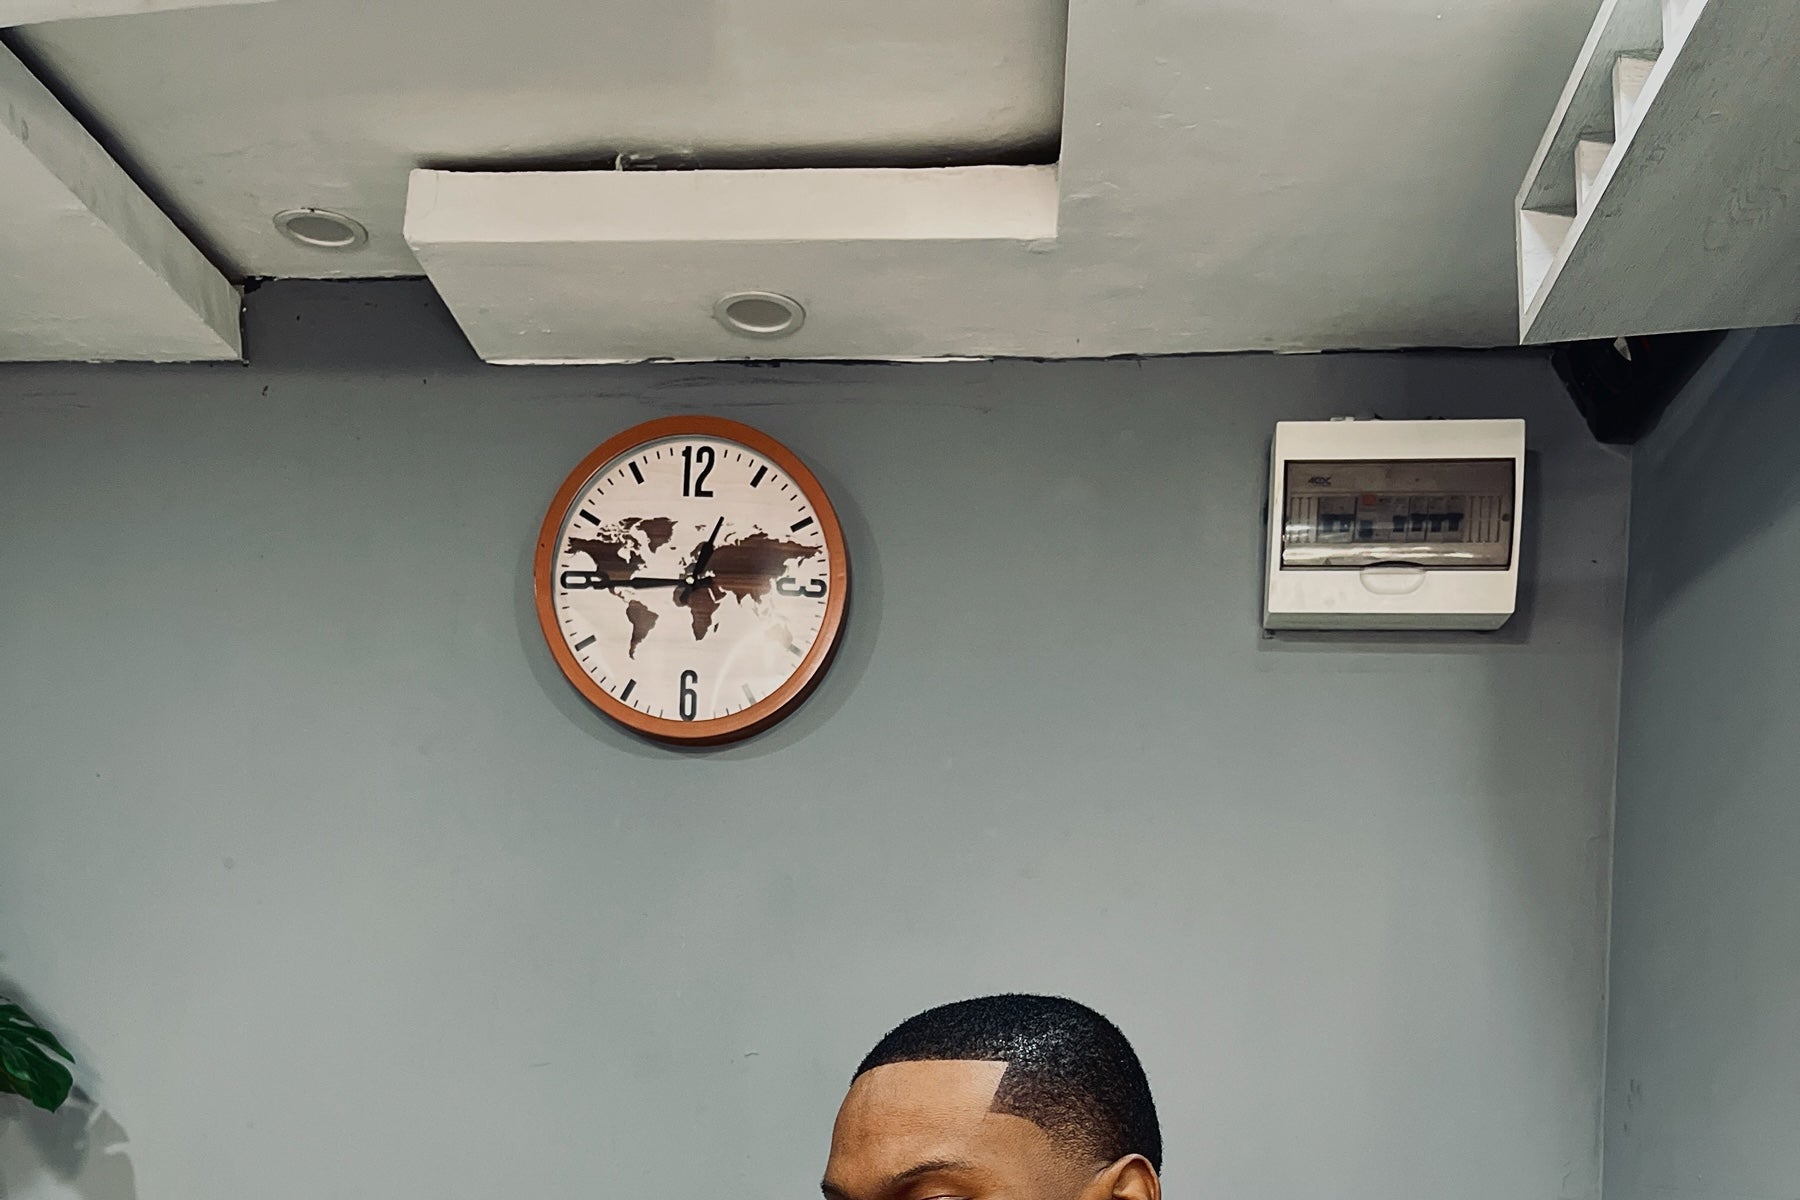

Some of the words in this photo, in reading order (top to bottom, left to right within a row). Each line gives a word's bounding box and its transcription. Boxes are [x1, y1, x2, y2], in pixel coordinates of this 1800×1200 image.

[682, 446, 716, 498] 12
[776, 577, 828, 599] 3
[679, 669, 698, 722] 6
